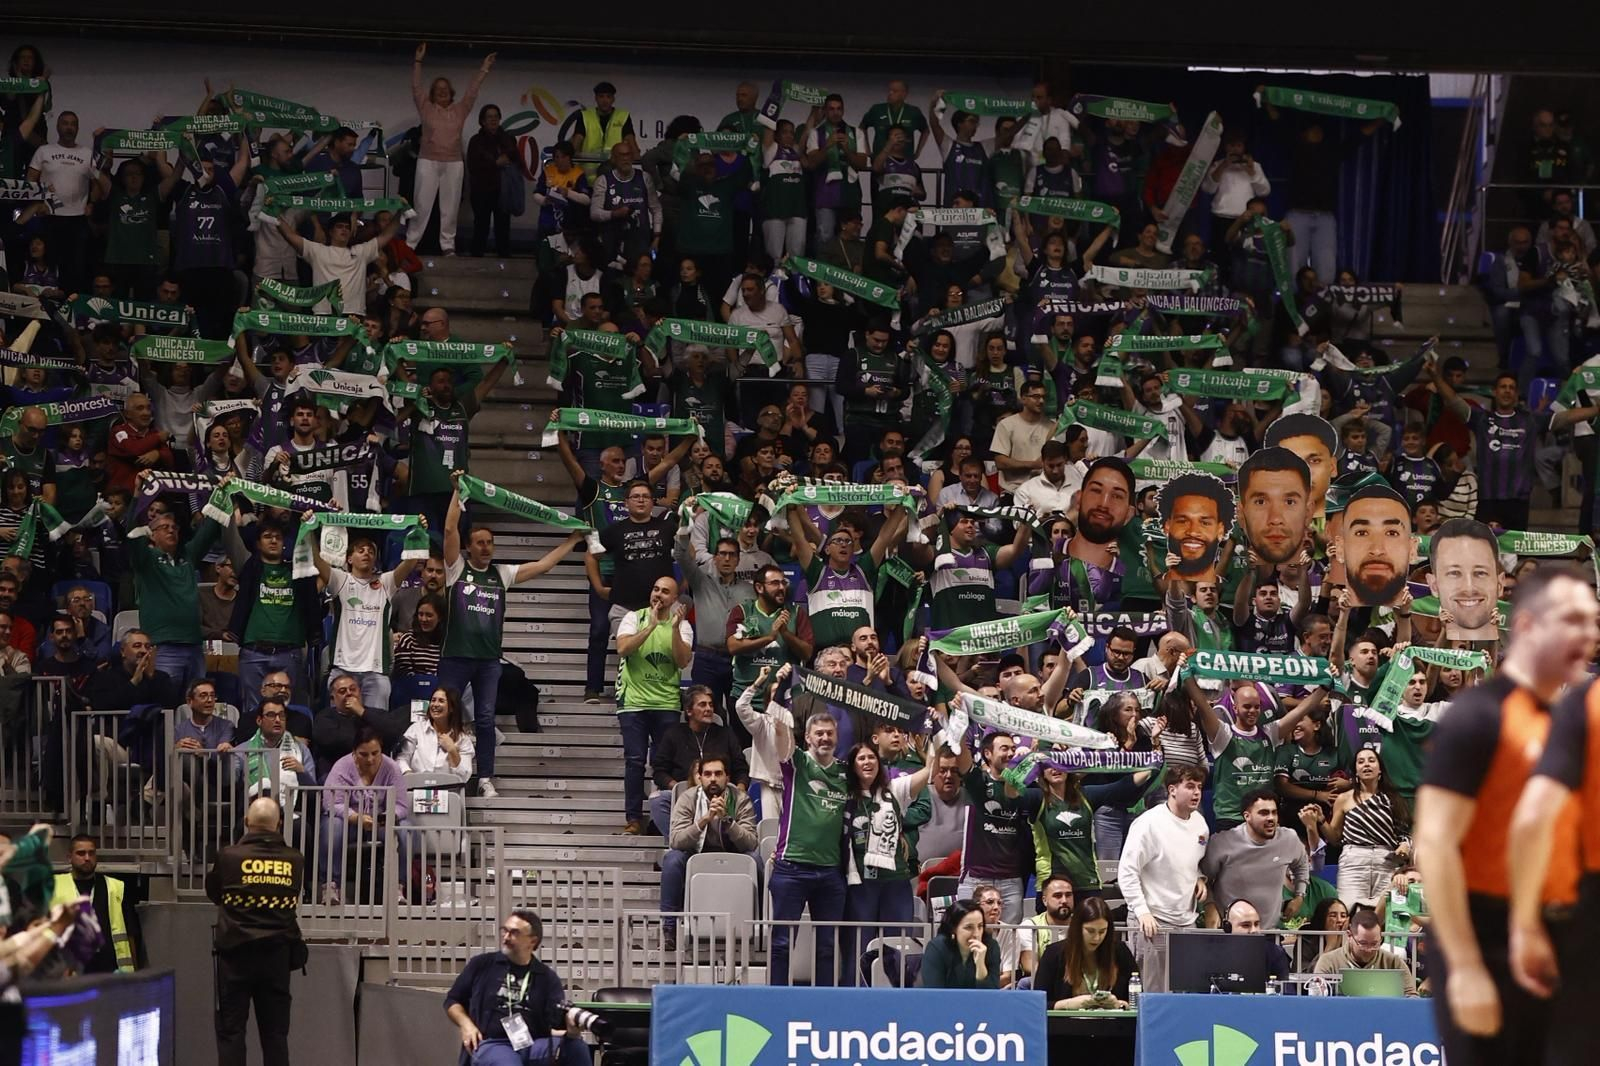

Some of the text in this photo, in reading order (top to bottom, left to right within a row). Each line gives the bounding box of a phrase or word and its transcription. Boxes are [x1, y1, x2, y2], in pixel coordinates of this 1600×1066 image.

[193, 114, 230, 124] UNICAJA
[186, 122, 239, 132] BALONCESTO
[119, 139, 175, 149] BALONCESTO
[128, 131, 166, 142] UNICAJA
[197, 216, 215, 229] 77
[826, 265, 868, 288] Unicaja
[118, 301, 187, 325] Unicaj
[279, 312, 328, 327] Unicaja
[690, 323, 739, 338] Unicaja
[155, 338, 196, 350] UNICAJA
[574, 331, 619, 347] Unicaja
[147, 347, 205, 361] BALONCESTO
[427, 341, 476, 353] Unicaja
[333, 381, 363, 394] Unicaja
[1202, 373, 1251, 390] Unicaja
[1096, 408, 1137, 427] Unicaja
[297, 442, 373, 469] UNICA
[142, 470, 214, 496] UNICA
[351, 474, 368, 489] 55
[828, 492, 885, 502] histórico
[503, 496, 553, 520] histórico
[326, 513, 385, 525] histórico
[1514, 540, 1577, 553] BALONCESTO
[476, 590, 499, 601] Unicaja
[958, 592, 986, 601] málaga
[467, 604, 496, 616] málaga
[831, 610, 860, 619] málaga
[349, 617, 377, 627] málaga
[969, 619, 1020, 638] UNICAJA
[1077, 613, 1168, 635] ICAJA
[960, 629, 1033, 652] BALONCESTO
[752, 656, 778, 665] Unicaja
[1196, 652, 1318, 678] CAMPEÓN
[1412, 647, 1473, 668] histórico
[806, 673, 900, 721] UNICAJA BALONCESTO
[1050, 750, 1102, 768] UNICAJA
[1059, 829, 1083, 837] Unicaja
[241, 859, 292, 876] COFER
[241, 874, 292, 887] SEGURIDAD
[786, 1022, 1026, 1062] Fundación
[1273, 1032, 1445, 1066] Fundac
